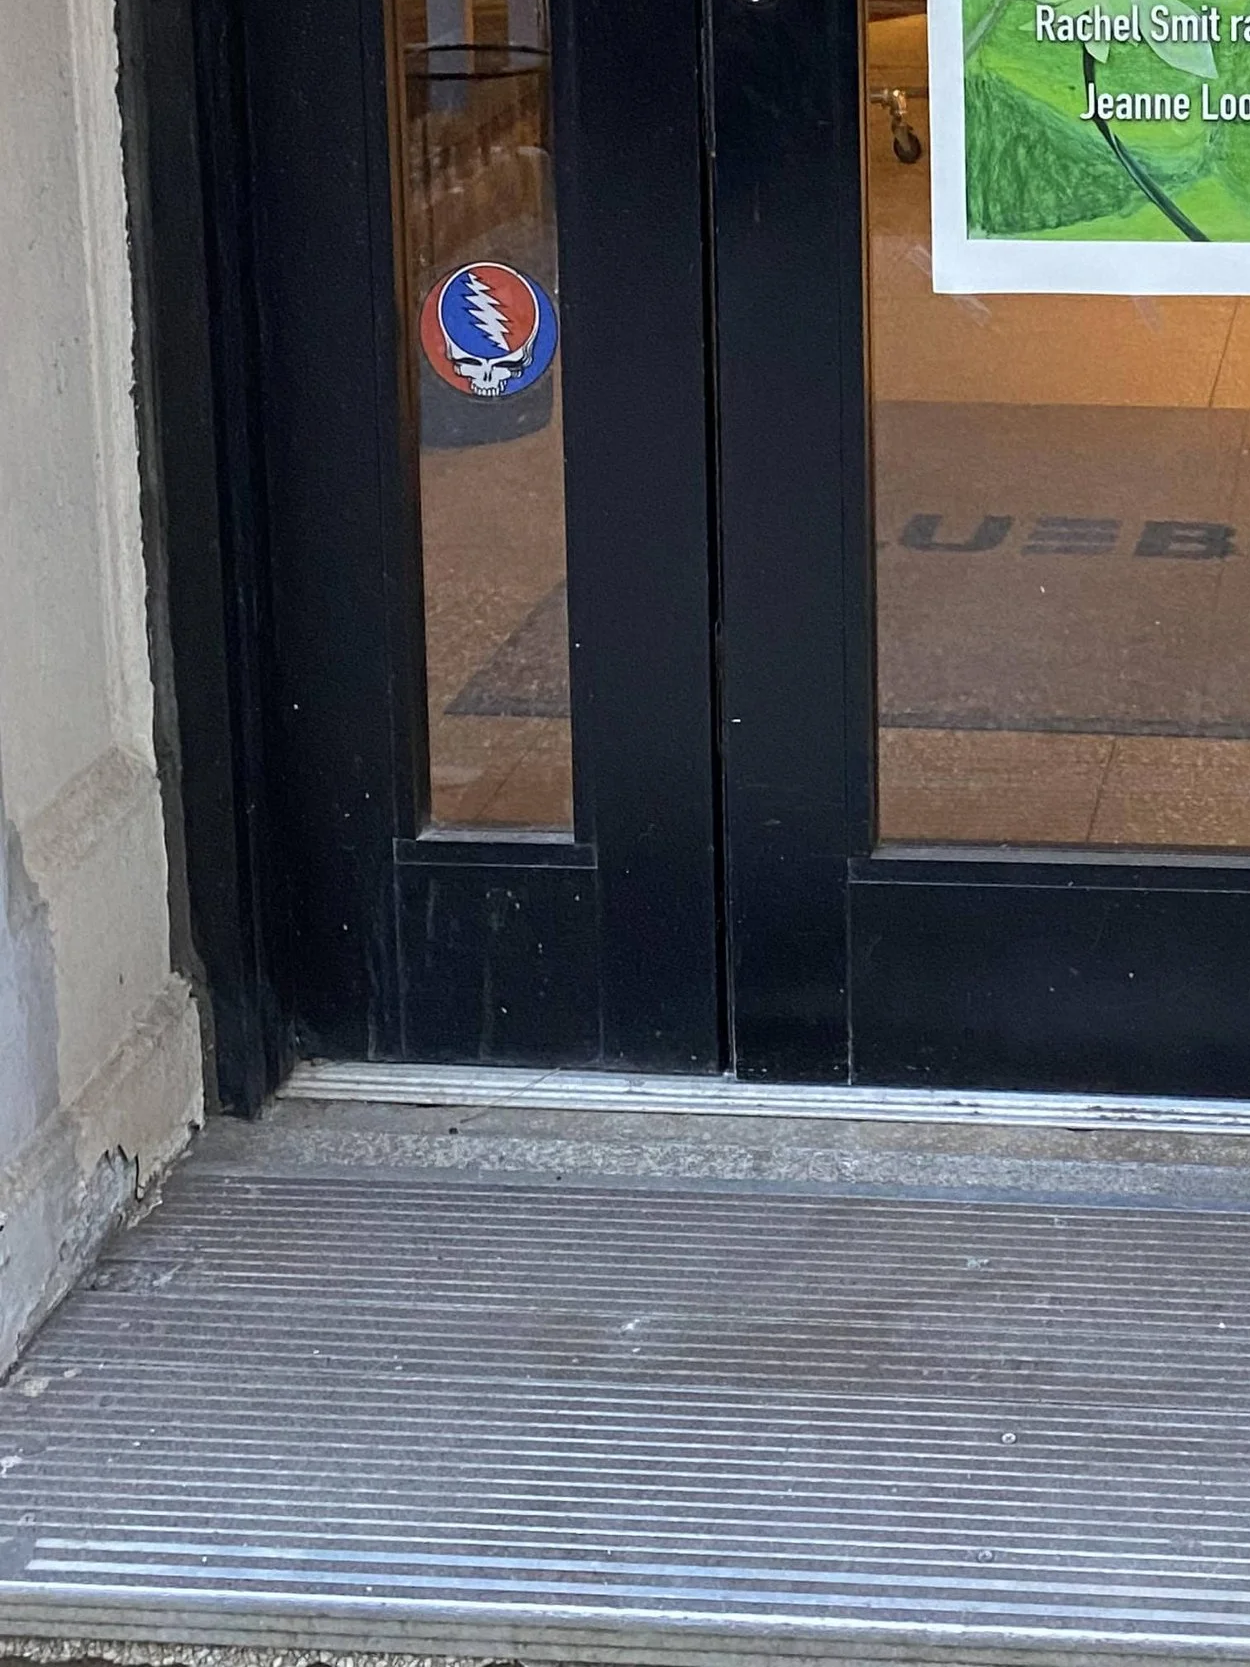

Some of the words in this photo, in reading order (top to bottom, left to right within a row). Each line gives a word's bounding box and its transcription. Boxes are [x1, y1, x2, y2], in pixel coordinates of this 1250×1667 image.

[1036, 4, 1142, 42] Rachel
[1150, 5, 1221, 42] Smit
[1080, 82, 1190, 120] Jeanne
